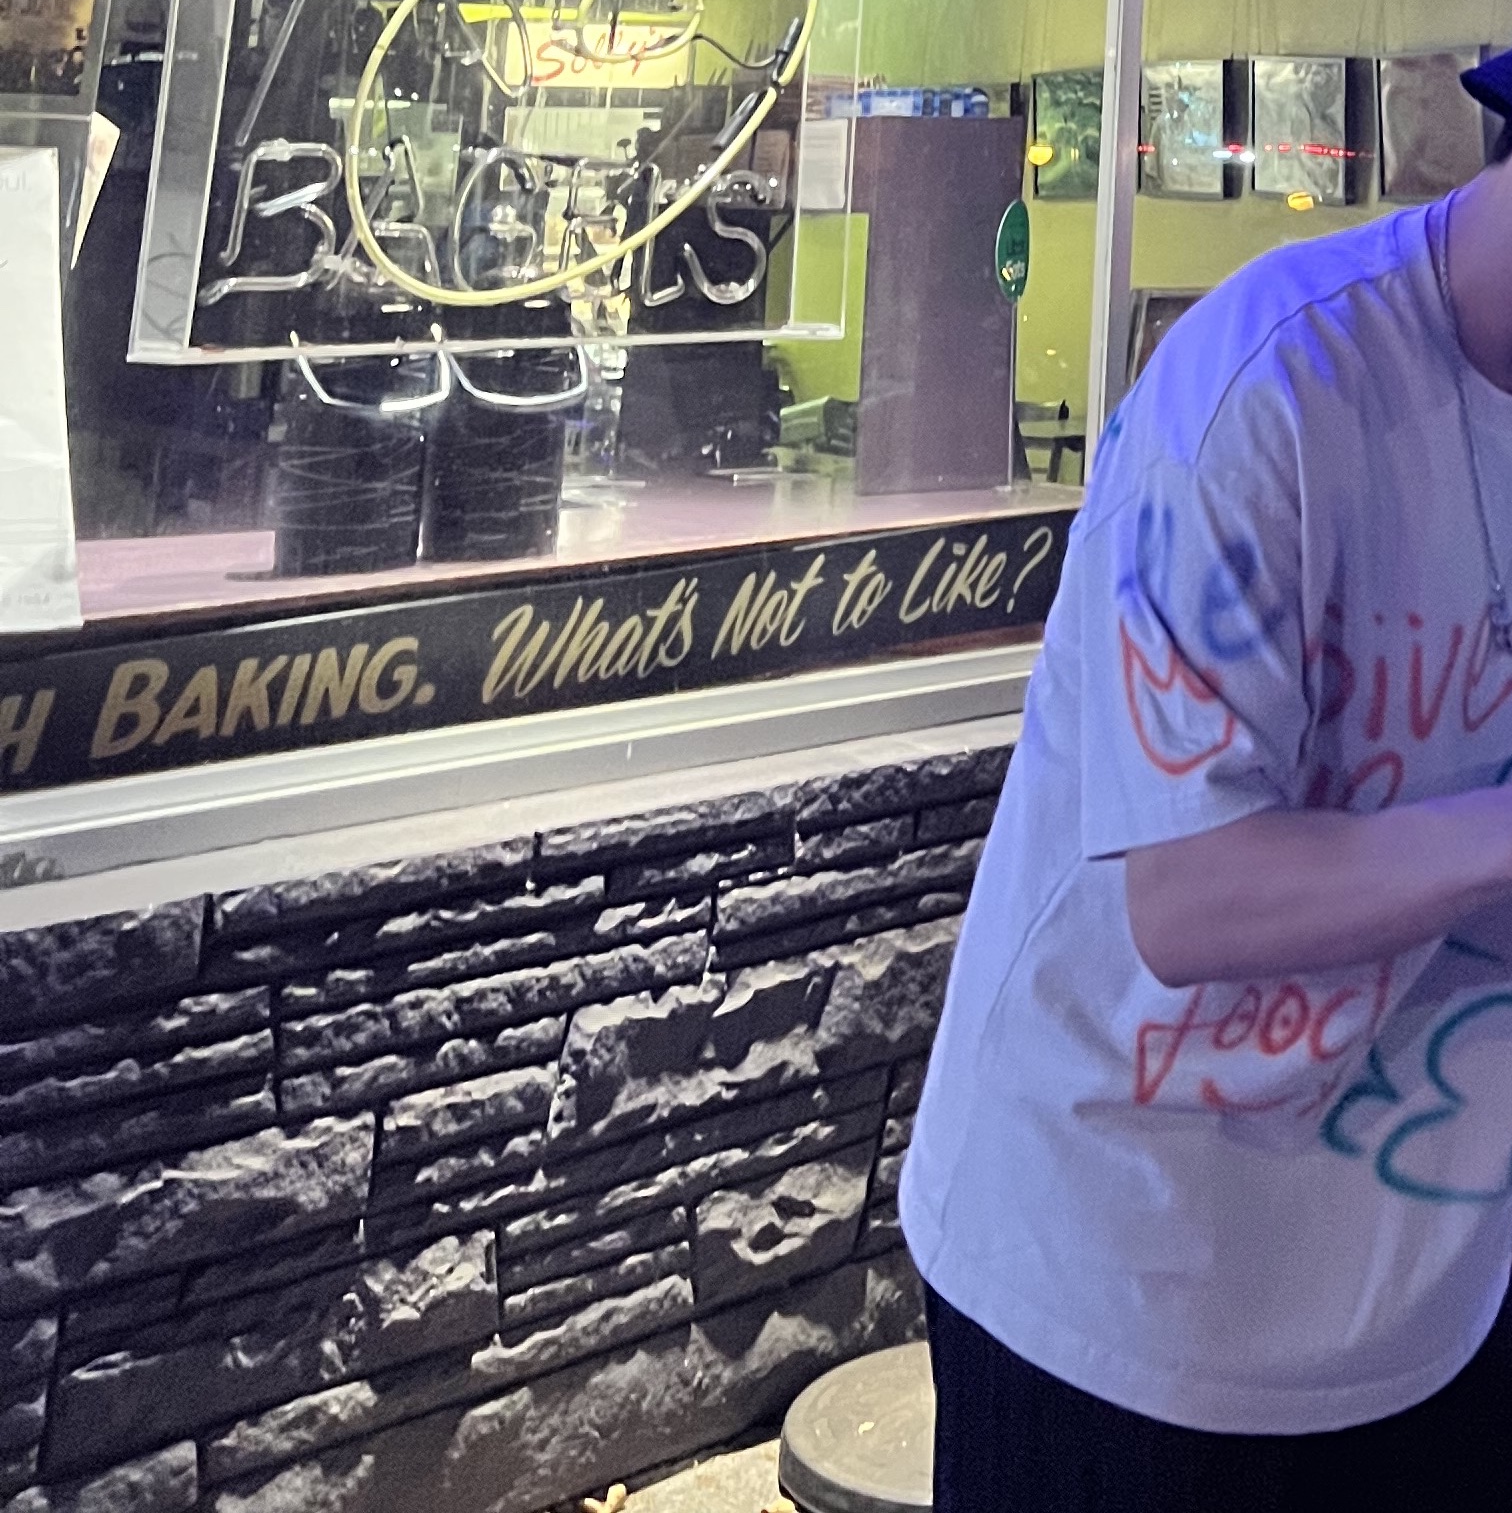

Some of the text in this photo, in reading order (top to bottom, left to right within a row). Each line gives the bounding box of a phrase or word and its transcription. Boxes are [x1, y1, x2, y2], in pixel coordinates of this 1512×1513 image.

[91, 636, 437, 759] BAKING.
[482, 577, 699, 705] What's
[711, 553, 823, 659] Not
[832, 548, 894, 636] to
[899, 525, 1054, 625] Like?
